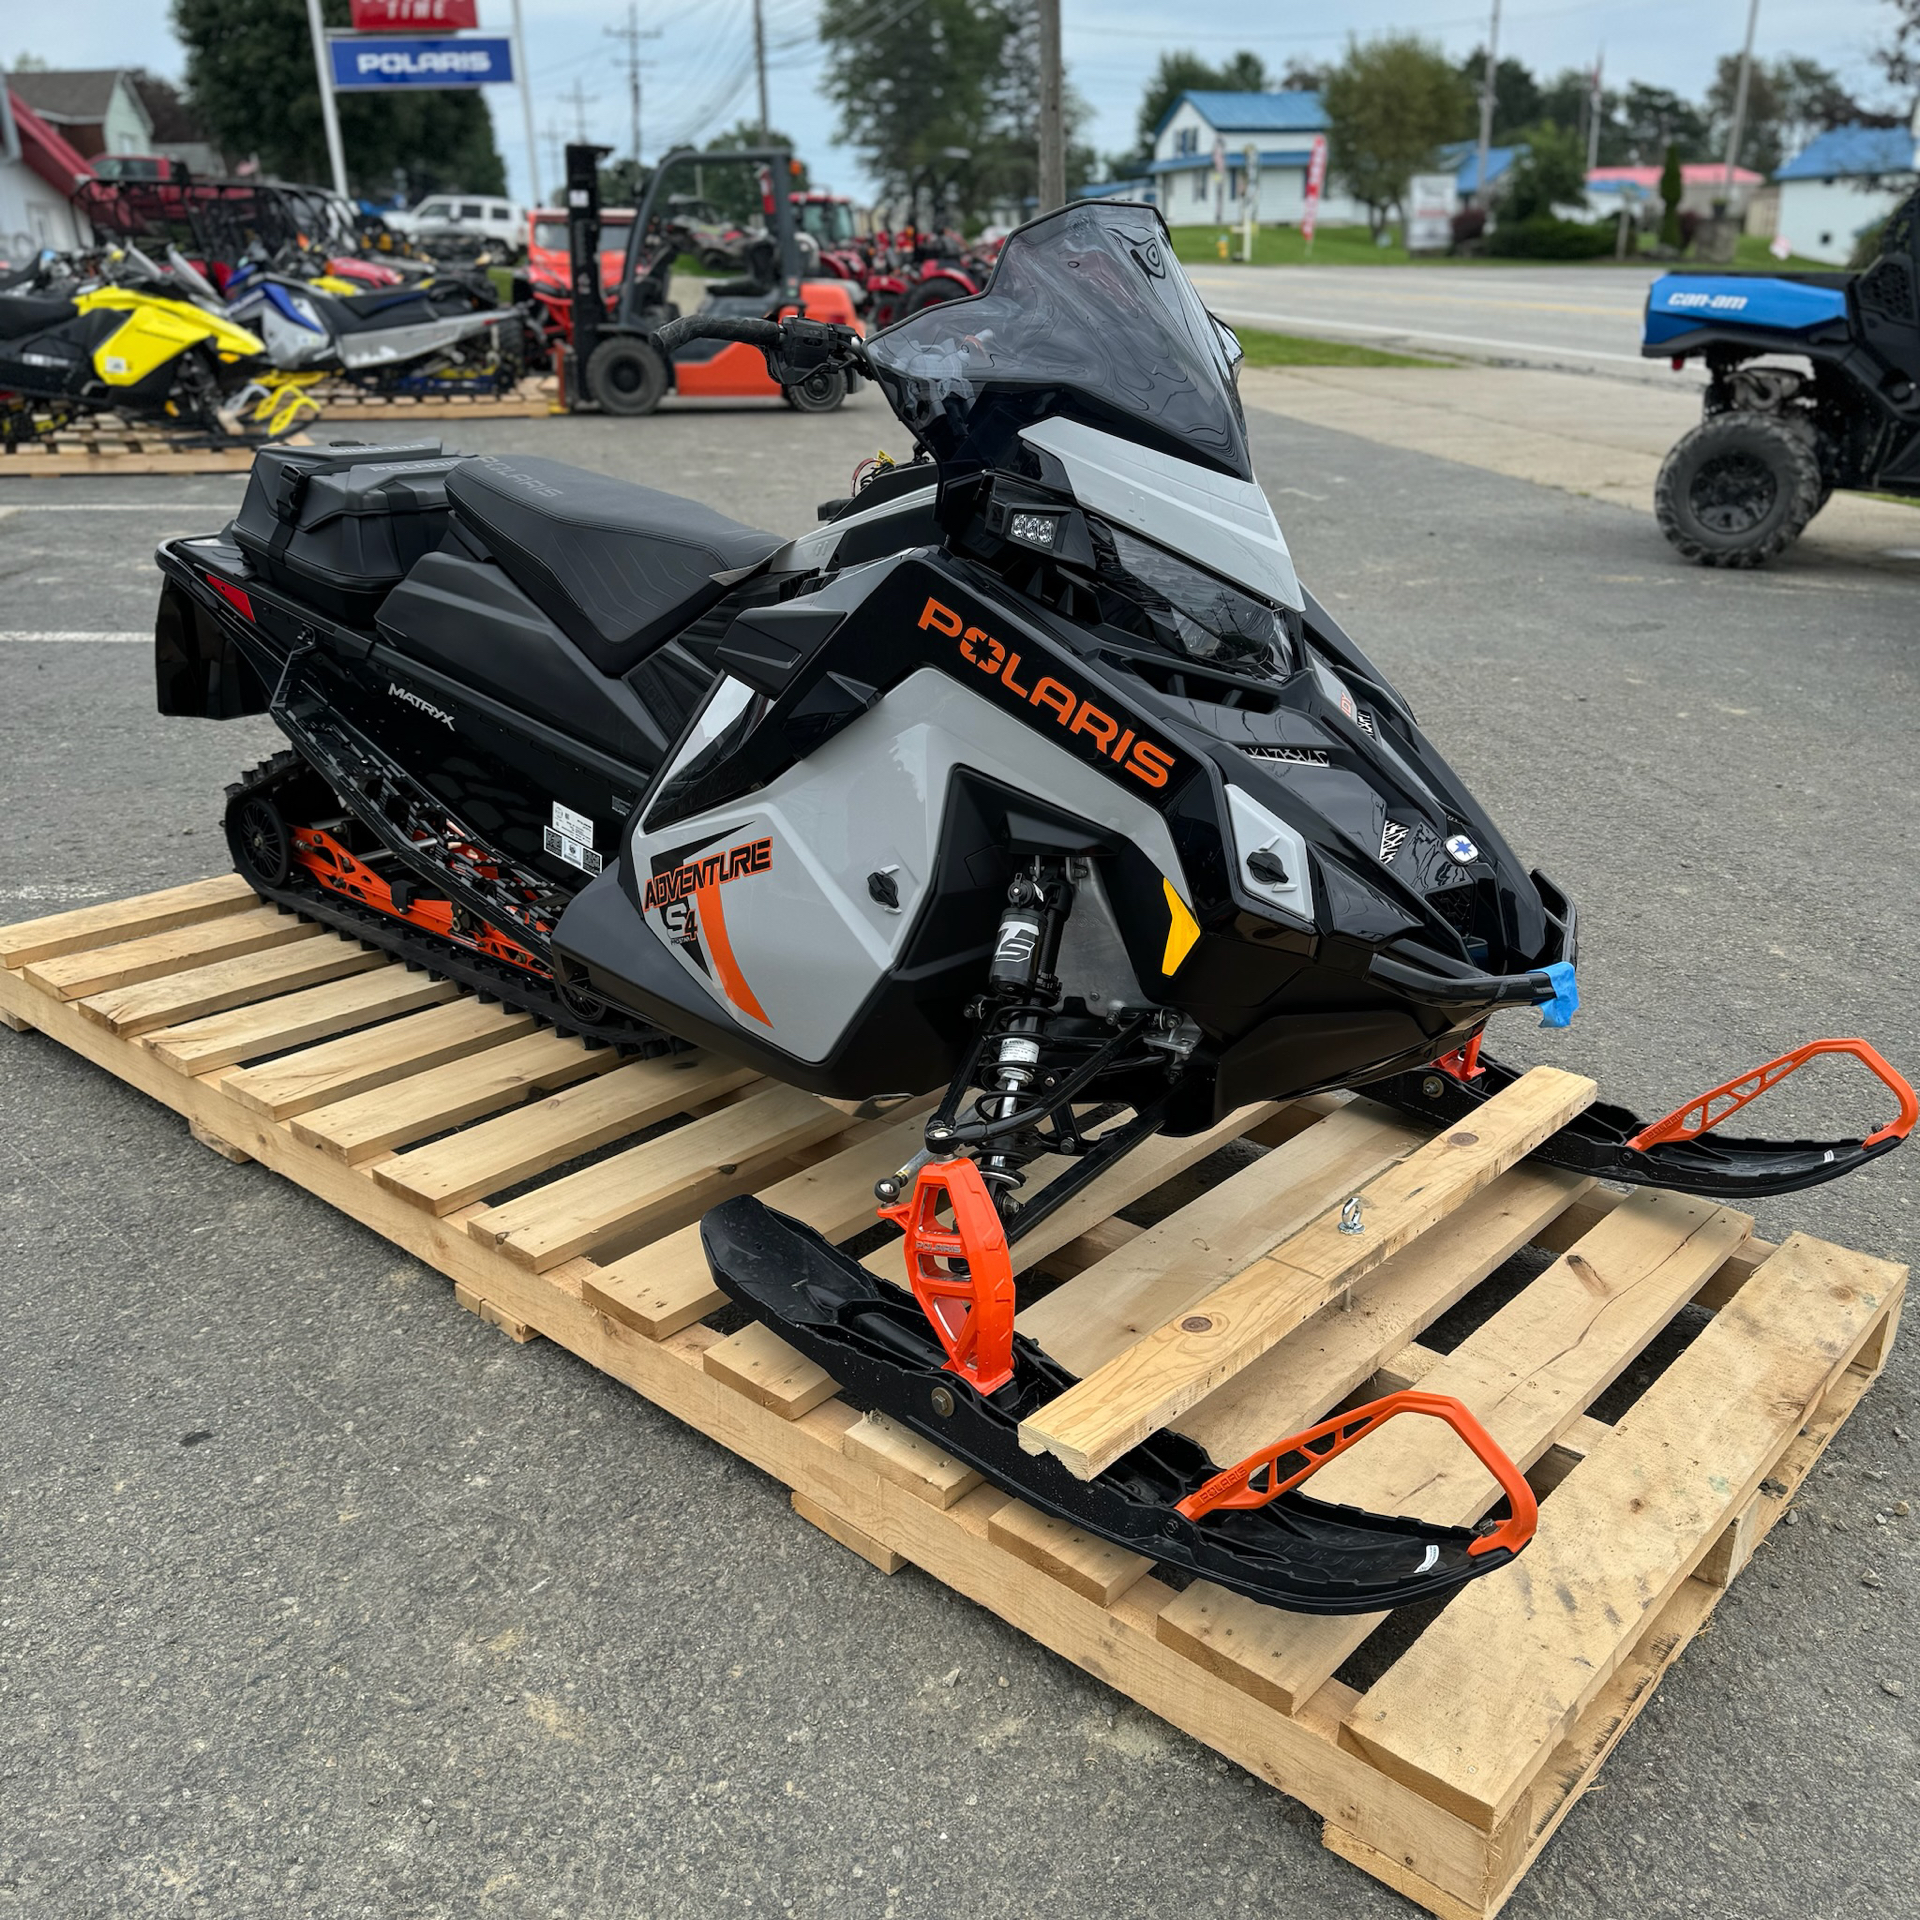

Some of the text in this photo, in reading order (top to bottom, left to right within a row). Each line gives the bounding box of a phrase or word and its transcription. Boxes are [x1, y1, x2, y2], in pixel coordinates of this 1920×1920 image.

[387, 0, 444, 19] TIME
[357, 52, 491, 74] POLARIS
[1667, 292, 1747, 311] can-am
[369, 460, 456, 472] POLARI
[480, 456, 564, 498] POLARIS
[388, 682, 455, 732] MATRYX
[918, 596, 1176, 788] POLARIS
[643, 836, 773, 912] ADVENTURE
[915, 1241, 961, 1253] POLARIS
[1199, 1466, 1247, 1504] POLARIS
